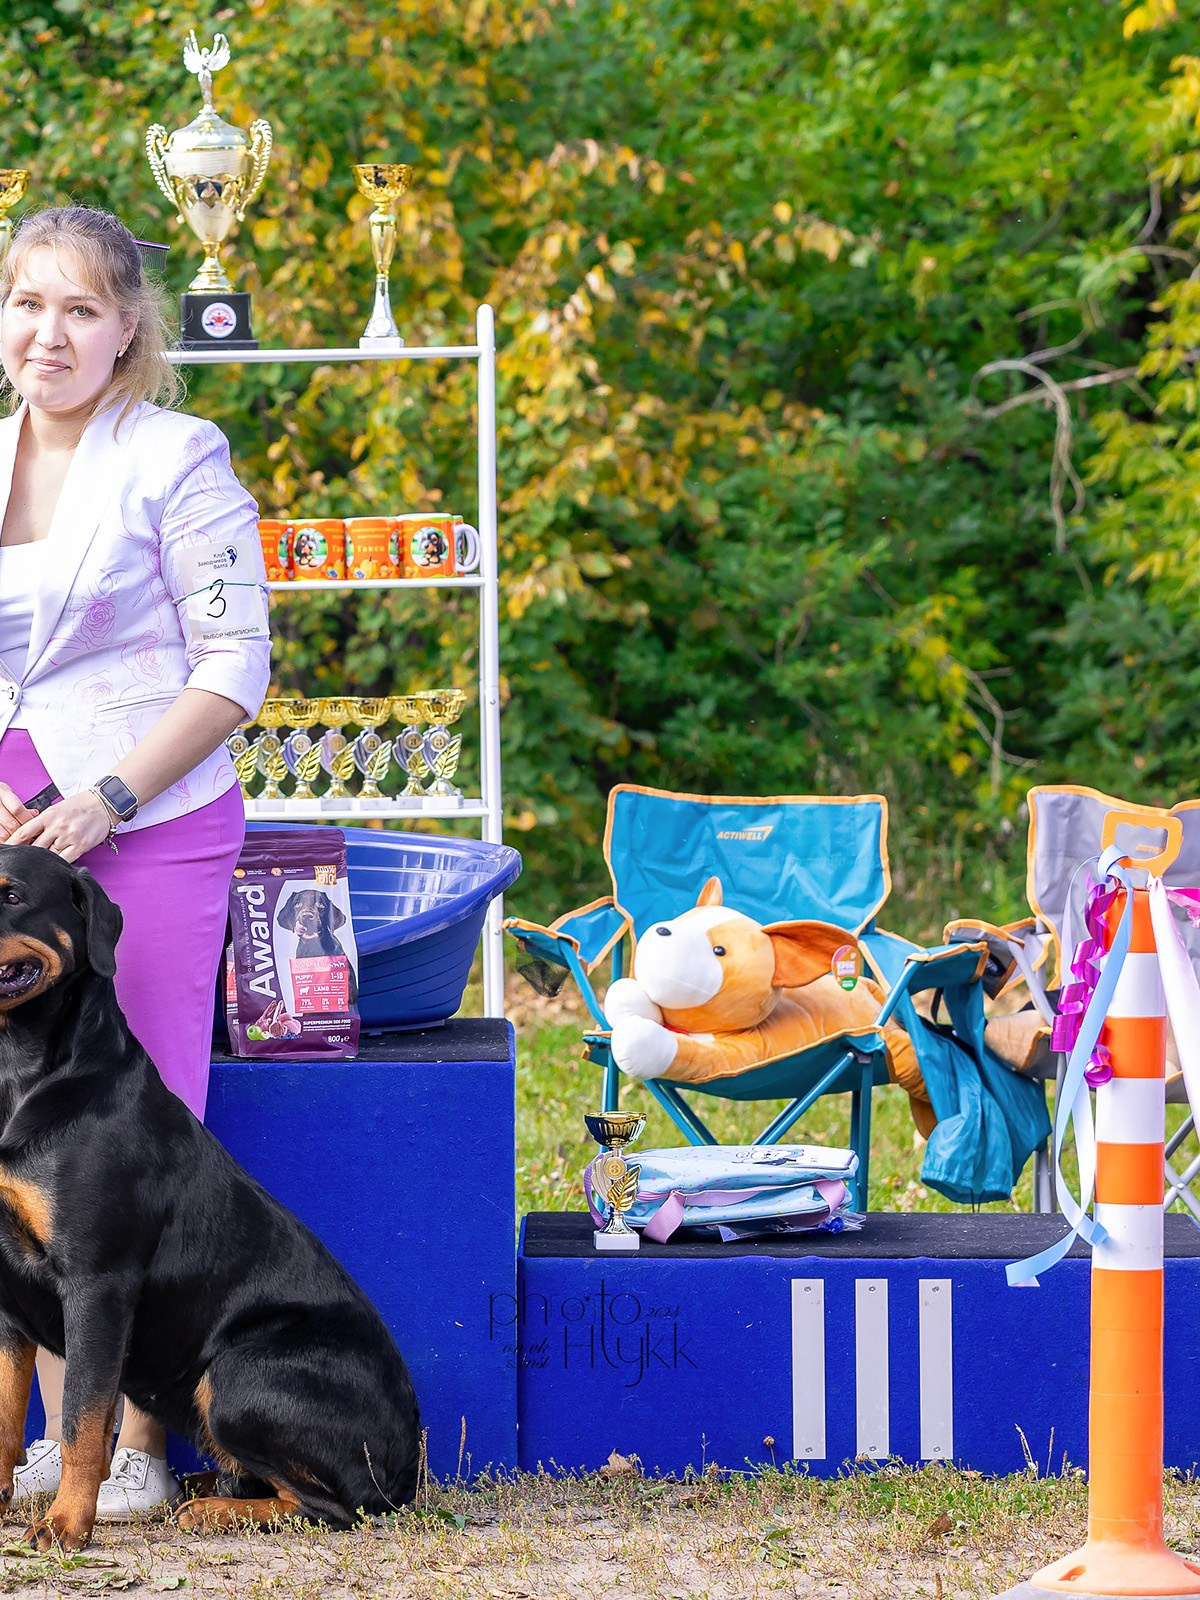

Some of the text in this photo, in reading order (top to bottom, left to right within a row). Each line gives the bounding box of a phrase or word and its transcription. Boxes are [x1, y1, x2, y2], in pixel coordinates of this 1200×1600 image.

[206, 578, 227, 619] 3
[202, 626, 260, 641] ВЫБОР ЧЕМПИОНОВ
[716, 831, 763, 841] ACTIWELL
[237, 884, 277, 999] Award
